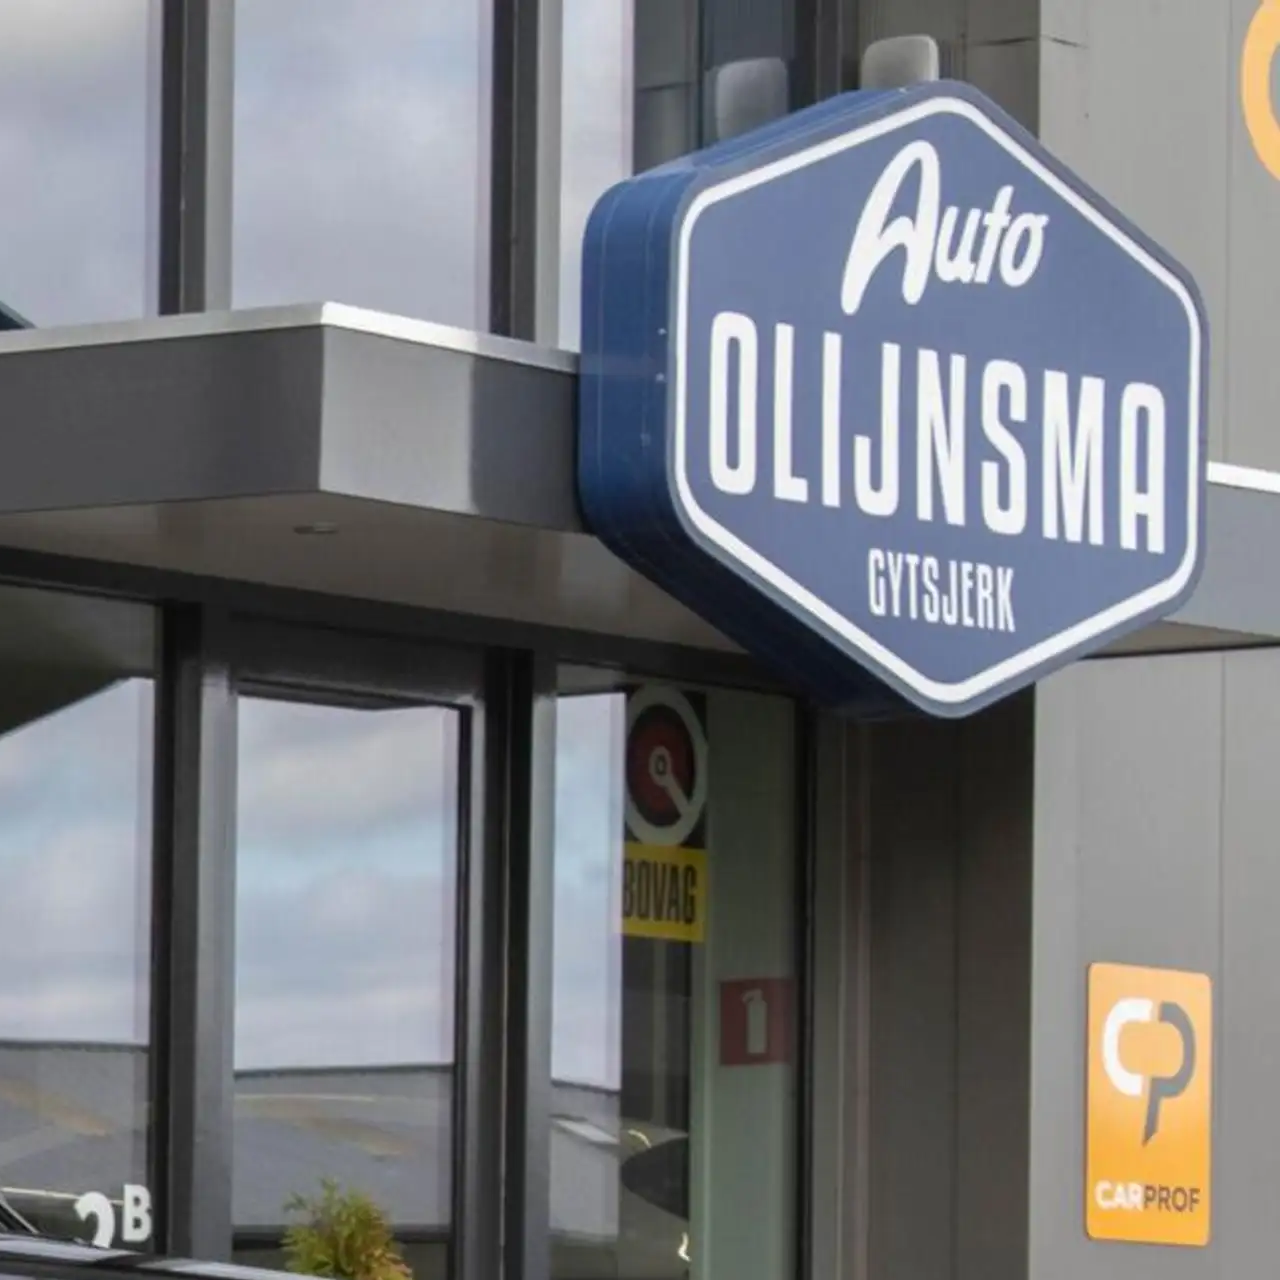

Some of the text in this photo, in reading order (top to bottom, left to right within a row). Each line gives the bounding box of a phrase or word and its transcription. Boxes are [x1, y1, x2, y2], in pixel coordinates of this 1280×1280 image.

[841, 139, 1049, 316] Auto
[709, 311, 1167, 555] OLIJNSMA
[867, 548, 1016, 633] GYTSJERK
[623, 859, 698, 926] BOVAG
[1094, 1180, 1202, 1213] CARPROF
